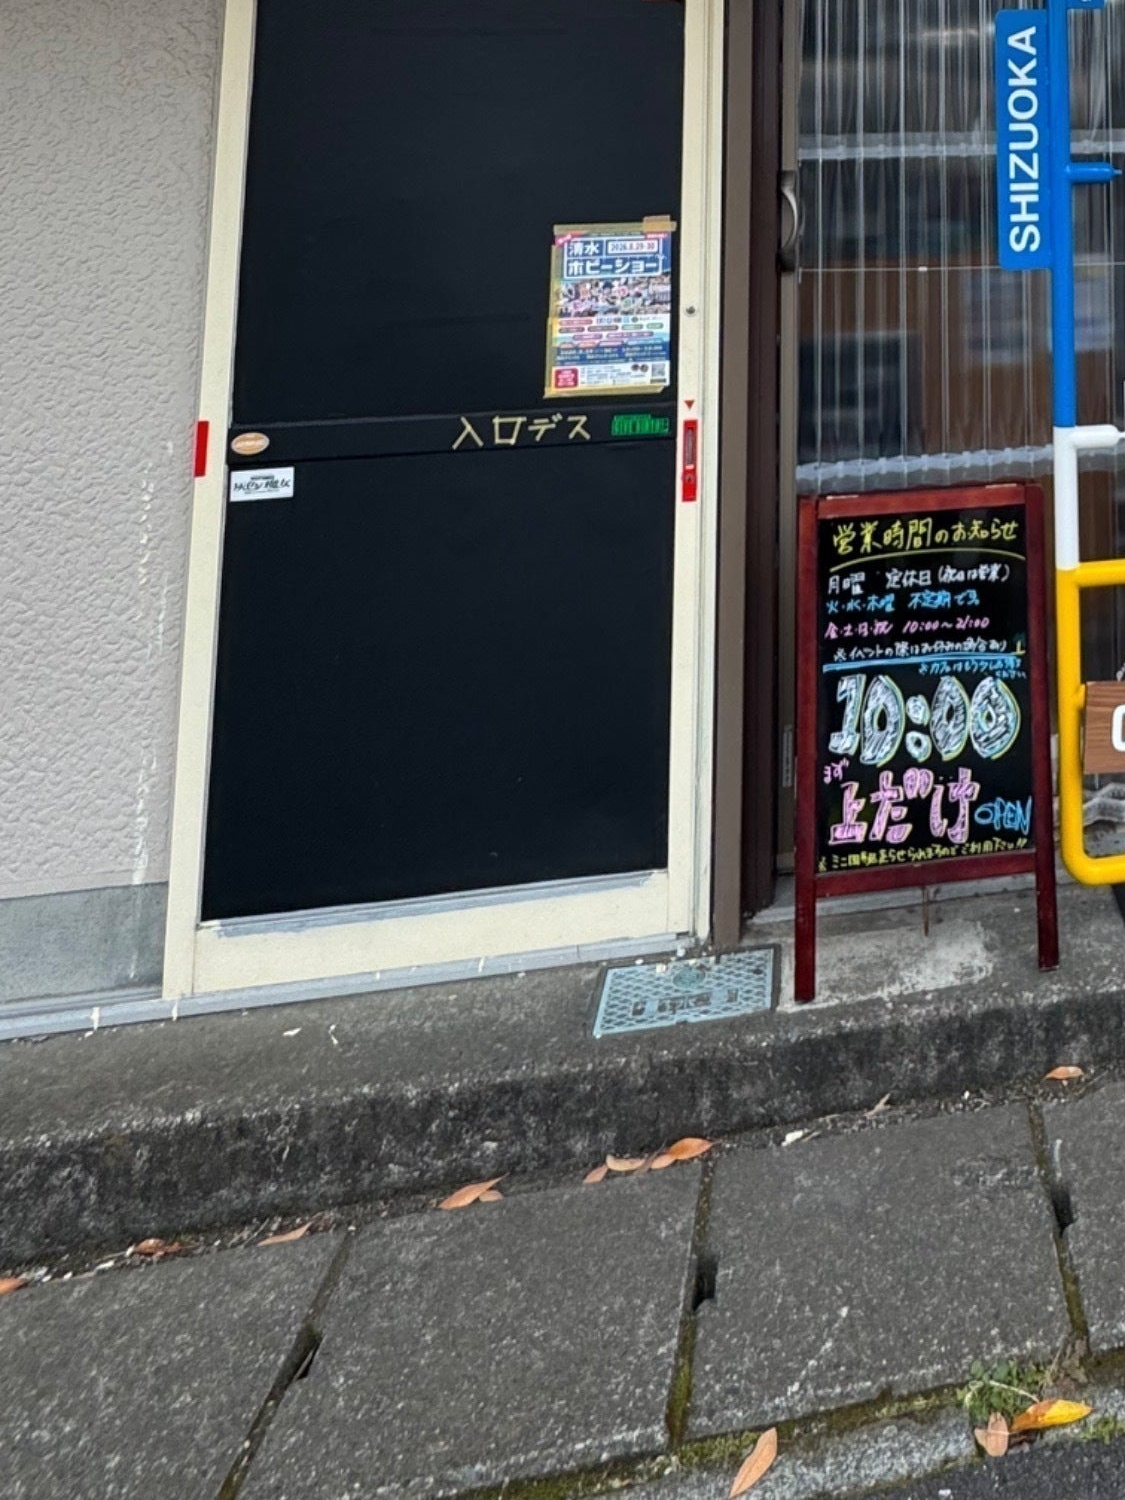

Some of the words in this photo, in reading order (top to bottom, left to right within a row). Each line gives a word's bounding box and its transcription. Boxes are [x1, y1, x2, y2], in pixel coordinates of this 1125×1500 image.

[1007, 26, 1041, 253] SHIZUOKA
[568, 259, 658, 276] ホビーショー
[569, 240, 600, 257] 清水
[452, 412, 592, 451] 入口デス
[832, 516, 1020, 556] 営業時間のお知らせ
[827, 571, 866, 595] 月曜
[828, 672, 1022, 768] 10:00
[974, 796, 1032, 835] OPEN
